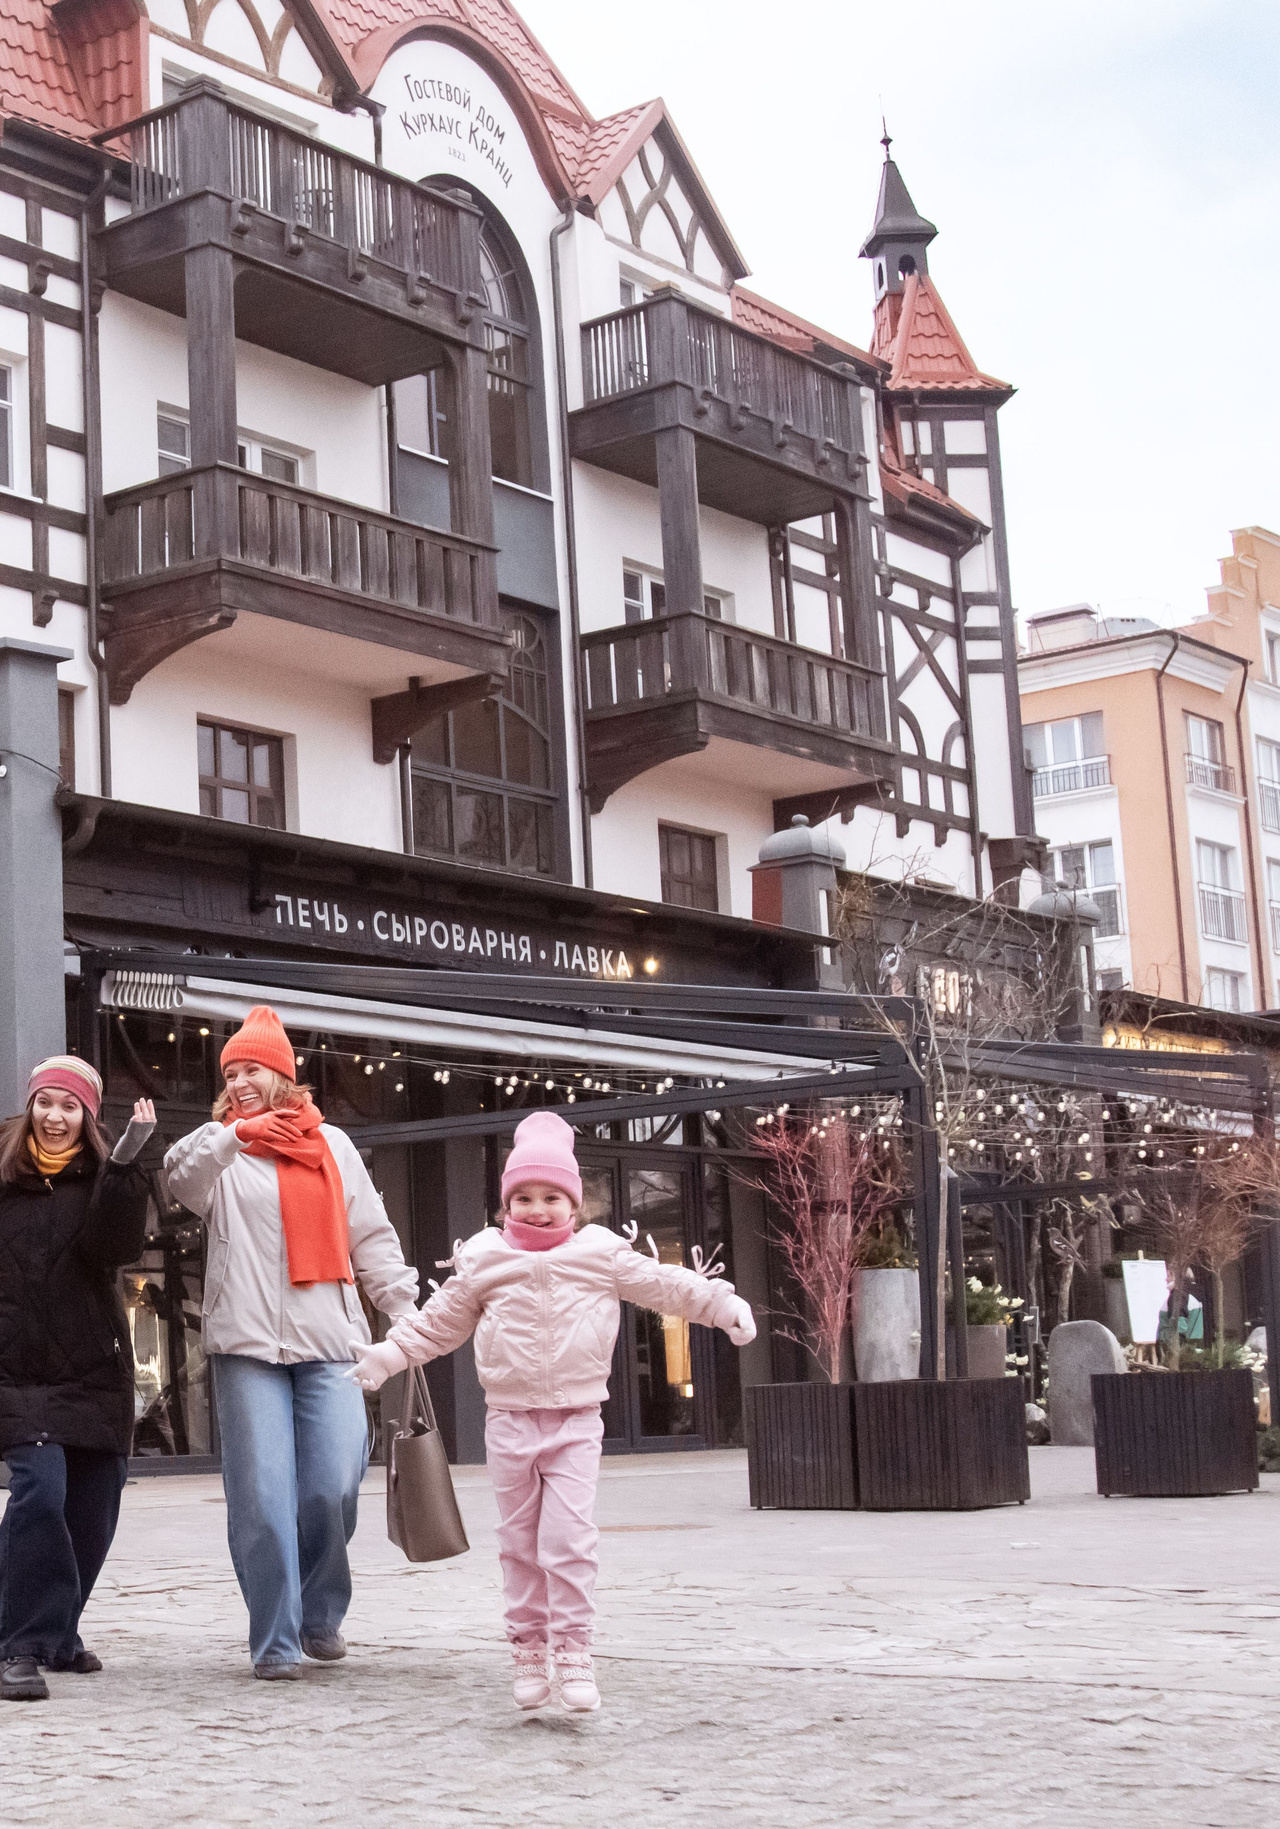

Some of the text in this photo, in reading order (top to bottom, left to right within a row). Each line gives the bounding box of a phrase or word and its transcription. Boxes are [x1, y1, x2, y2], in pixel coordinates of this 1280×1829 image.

[275, 894, 632, 978] ПЕЧЬ СЫРОВАРНЯ ЛАВКА
